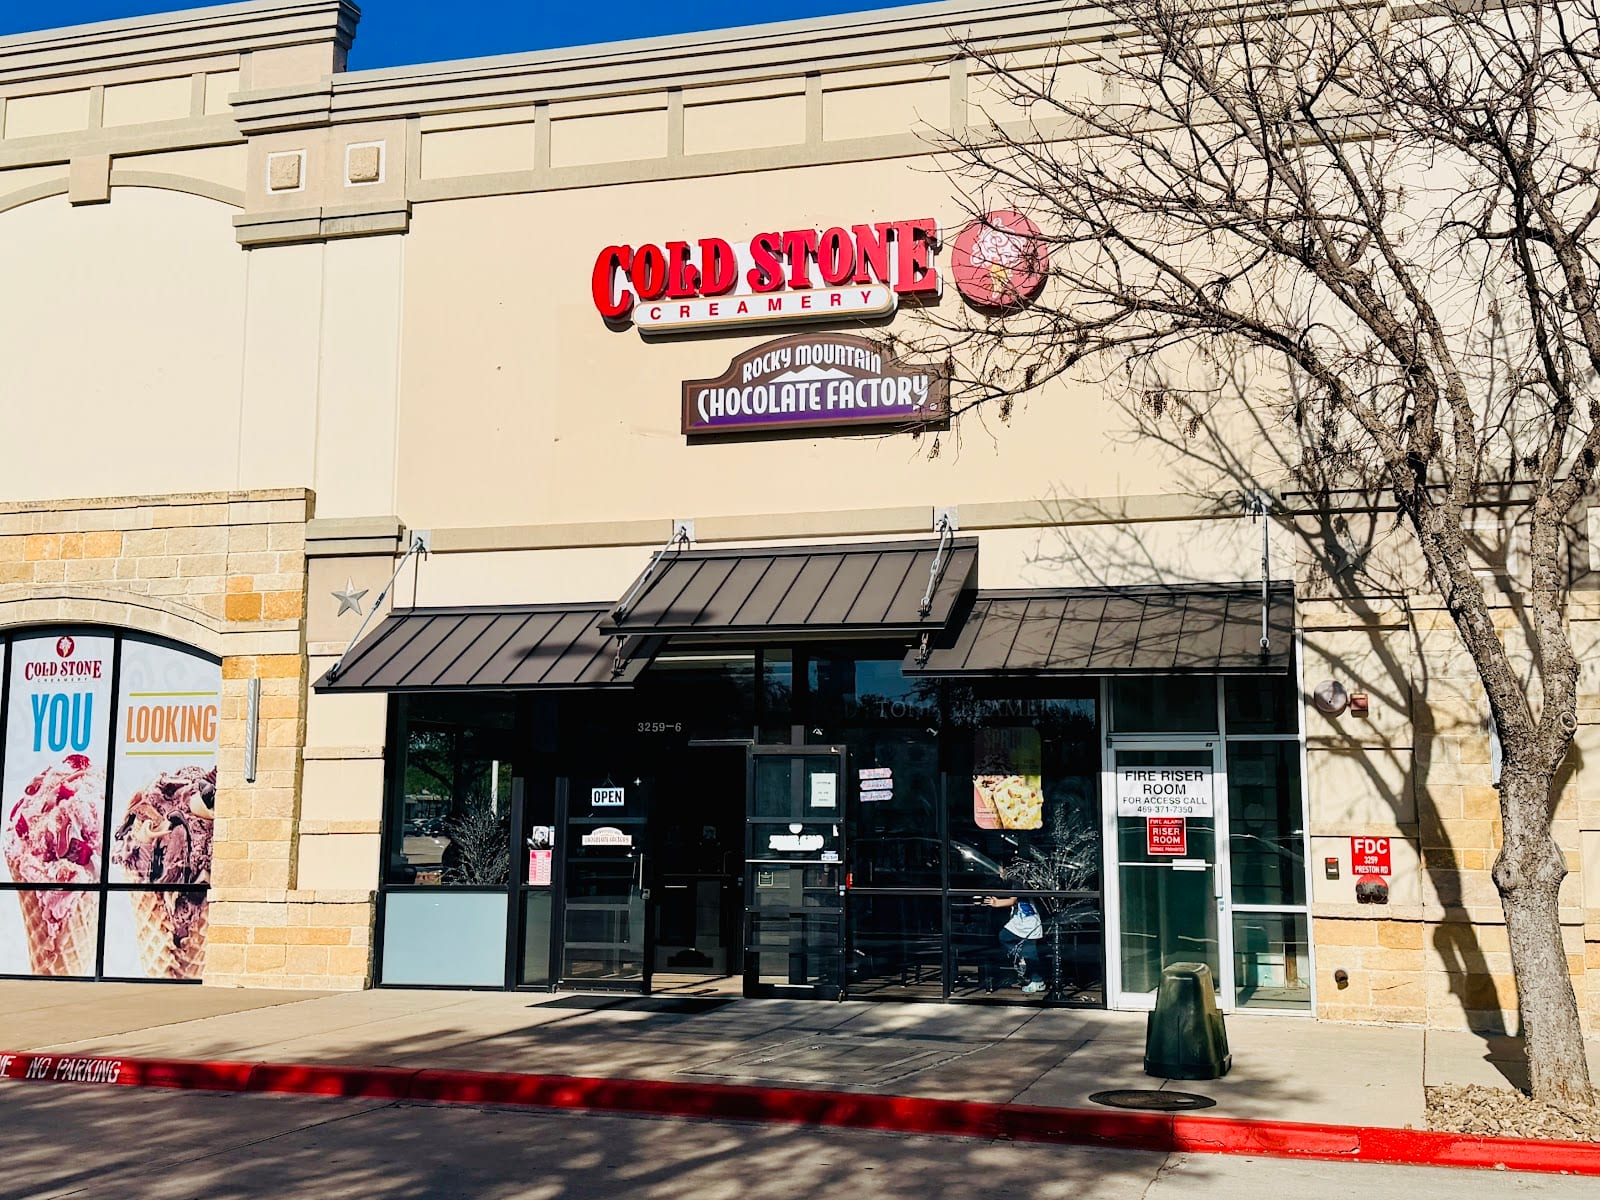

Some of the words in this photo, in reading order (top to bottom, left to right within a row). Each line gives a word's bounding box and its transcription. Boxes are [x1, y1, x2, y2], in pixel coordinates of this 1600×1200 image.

[592, 237, 738, 318] COLD
[747, 217, 940, 294] STONE
[650, 290, 872, 321] CREAMERY
[742, 352, 793, 384] ROCKY
[794, 343, 882, 376] MOUNTAIN
[697, 379, 822, 423] CHOCOLATE
[826, 374, 929, 412] FACTORY
[25, 661, 58, 681] COLD
[60, 660, 102, 679] STONE
[31, 692, 94, 752] YOU
[126, 705, 217, 744] LOOKING
[637, 722, 682, 733] 3259-6
[1125, 770, 1156, 782] FIRE
[1161, 770, 1204, 782] RISER
[1143, 783, 1186, 795] ROOM
[593, 790, 623, 804] OPEN
[1123, 797, 1142, 805] FOR
[1143, 797, 1181, 805] ACCESS
[1183, 797, 1208, 805] CALL
[1152, 827, 1180, 836] RISER
[1153, 836, 1181, 844] ROOM
[1354, 839, 1388, 854] FDC
[1354, 865, 1380, 874] PRESTON
[25, 1056, 53, 1079] NO
[53, 1057, 122, 1083] PARKING
